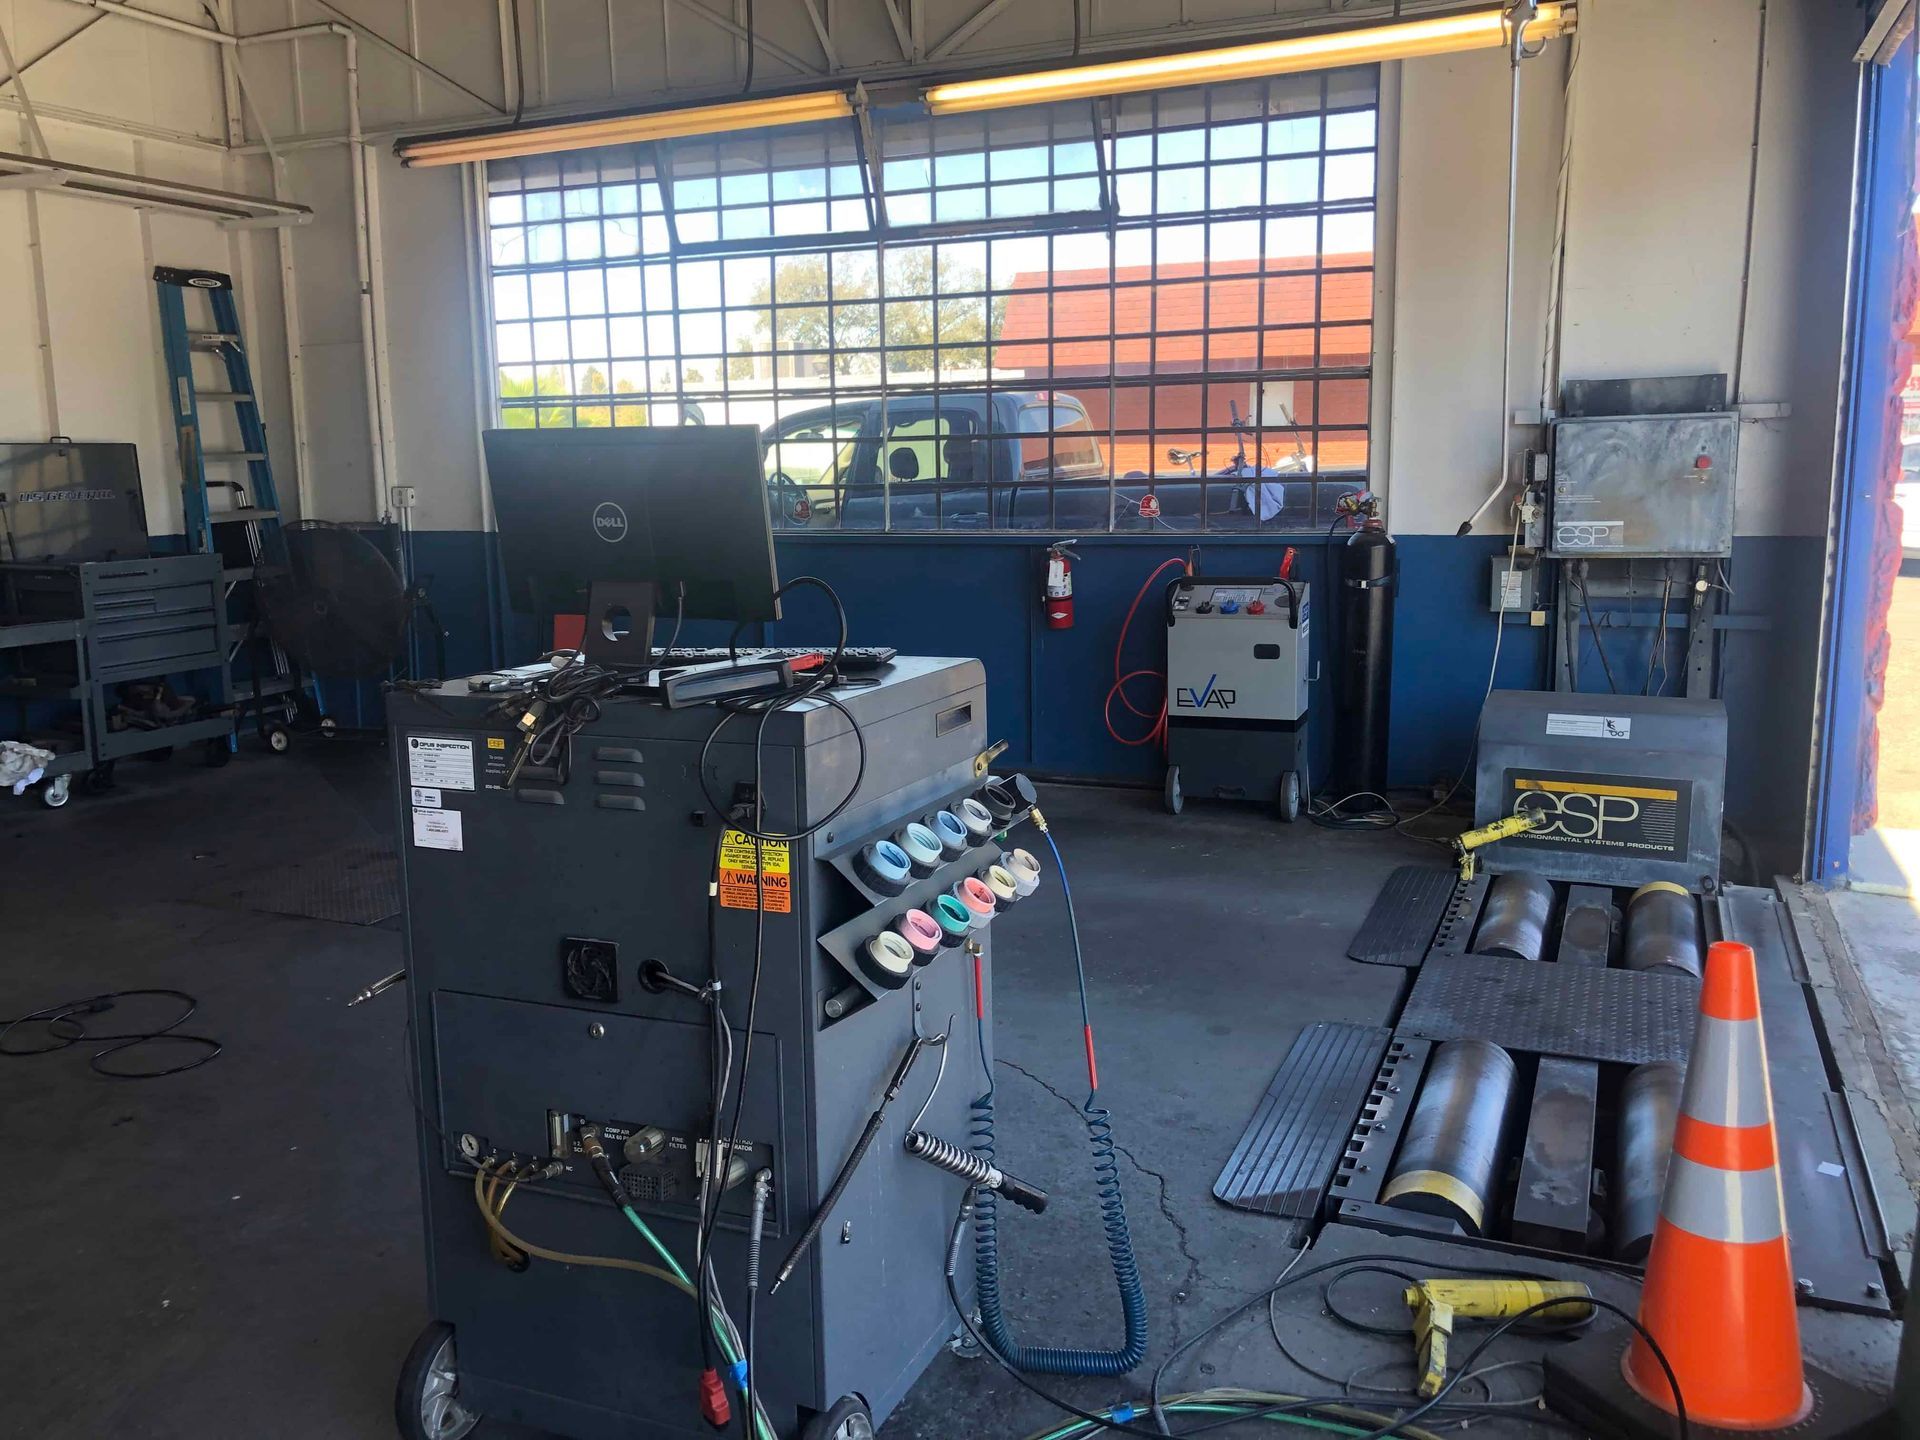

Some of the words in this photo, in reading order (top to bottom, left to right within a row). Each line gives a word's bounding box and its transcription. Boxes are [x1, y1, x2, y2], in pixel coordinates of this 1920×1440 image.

[596, 516, 625, 528] DELL
[1176, 673, 1236, 709] EVAP
[734, 834, 787, 848] CAUION
[1512, 833, 1582, 844] ENVIRONMENTAL
[1584, 838, 1625, 847] SYSTEMS
[1627, 842, 1675, 852] PRODUCTS
[605, 1126, 620, 1134] COMP
[669, 1142, 687, 1150] FILTER
